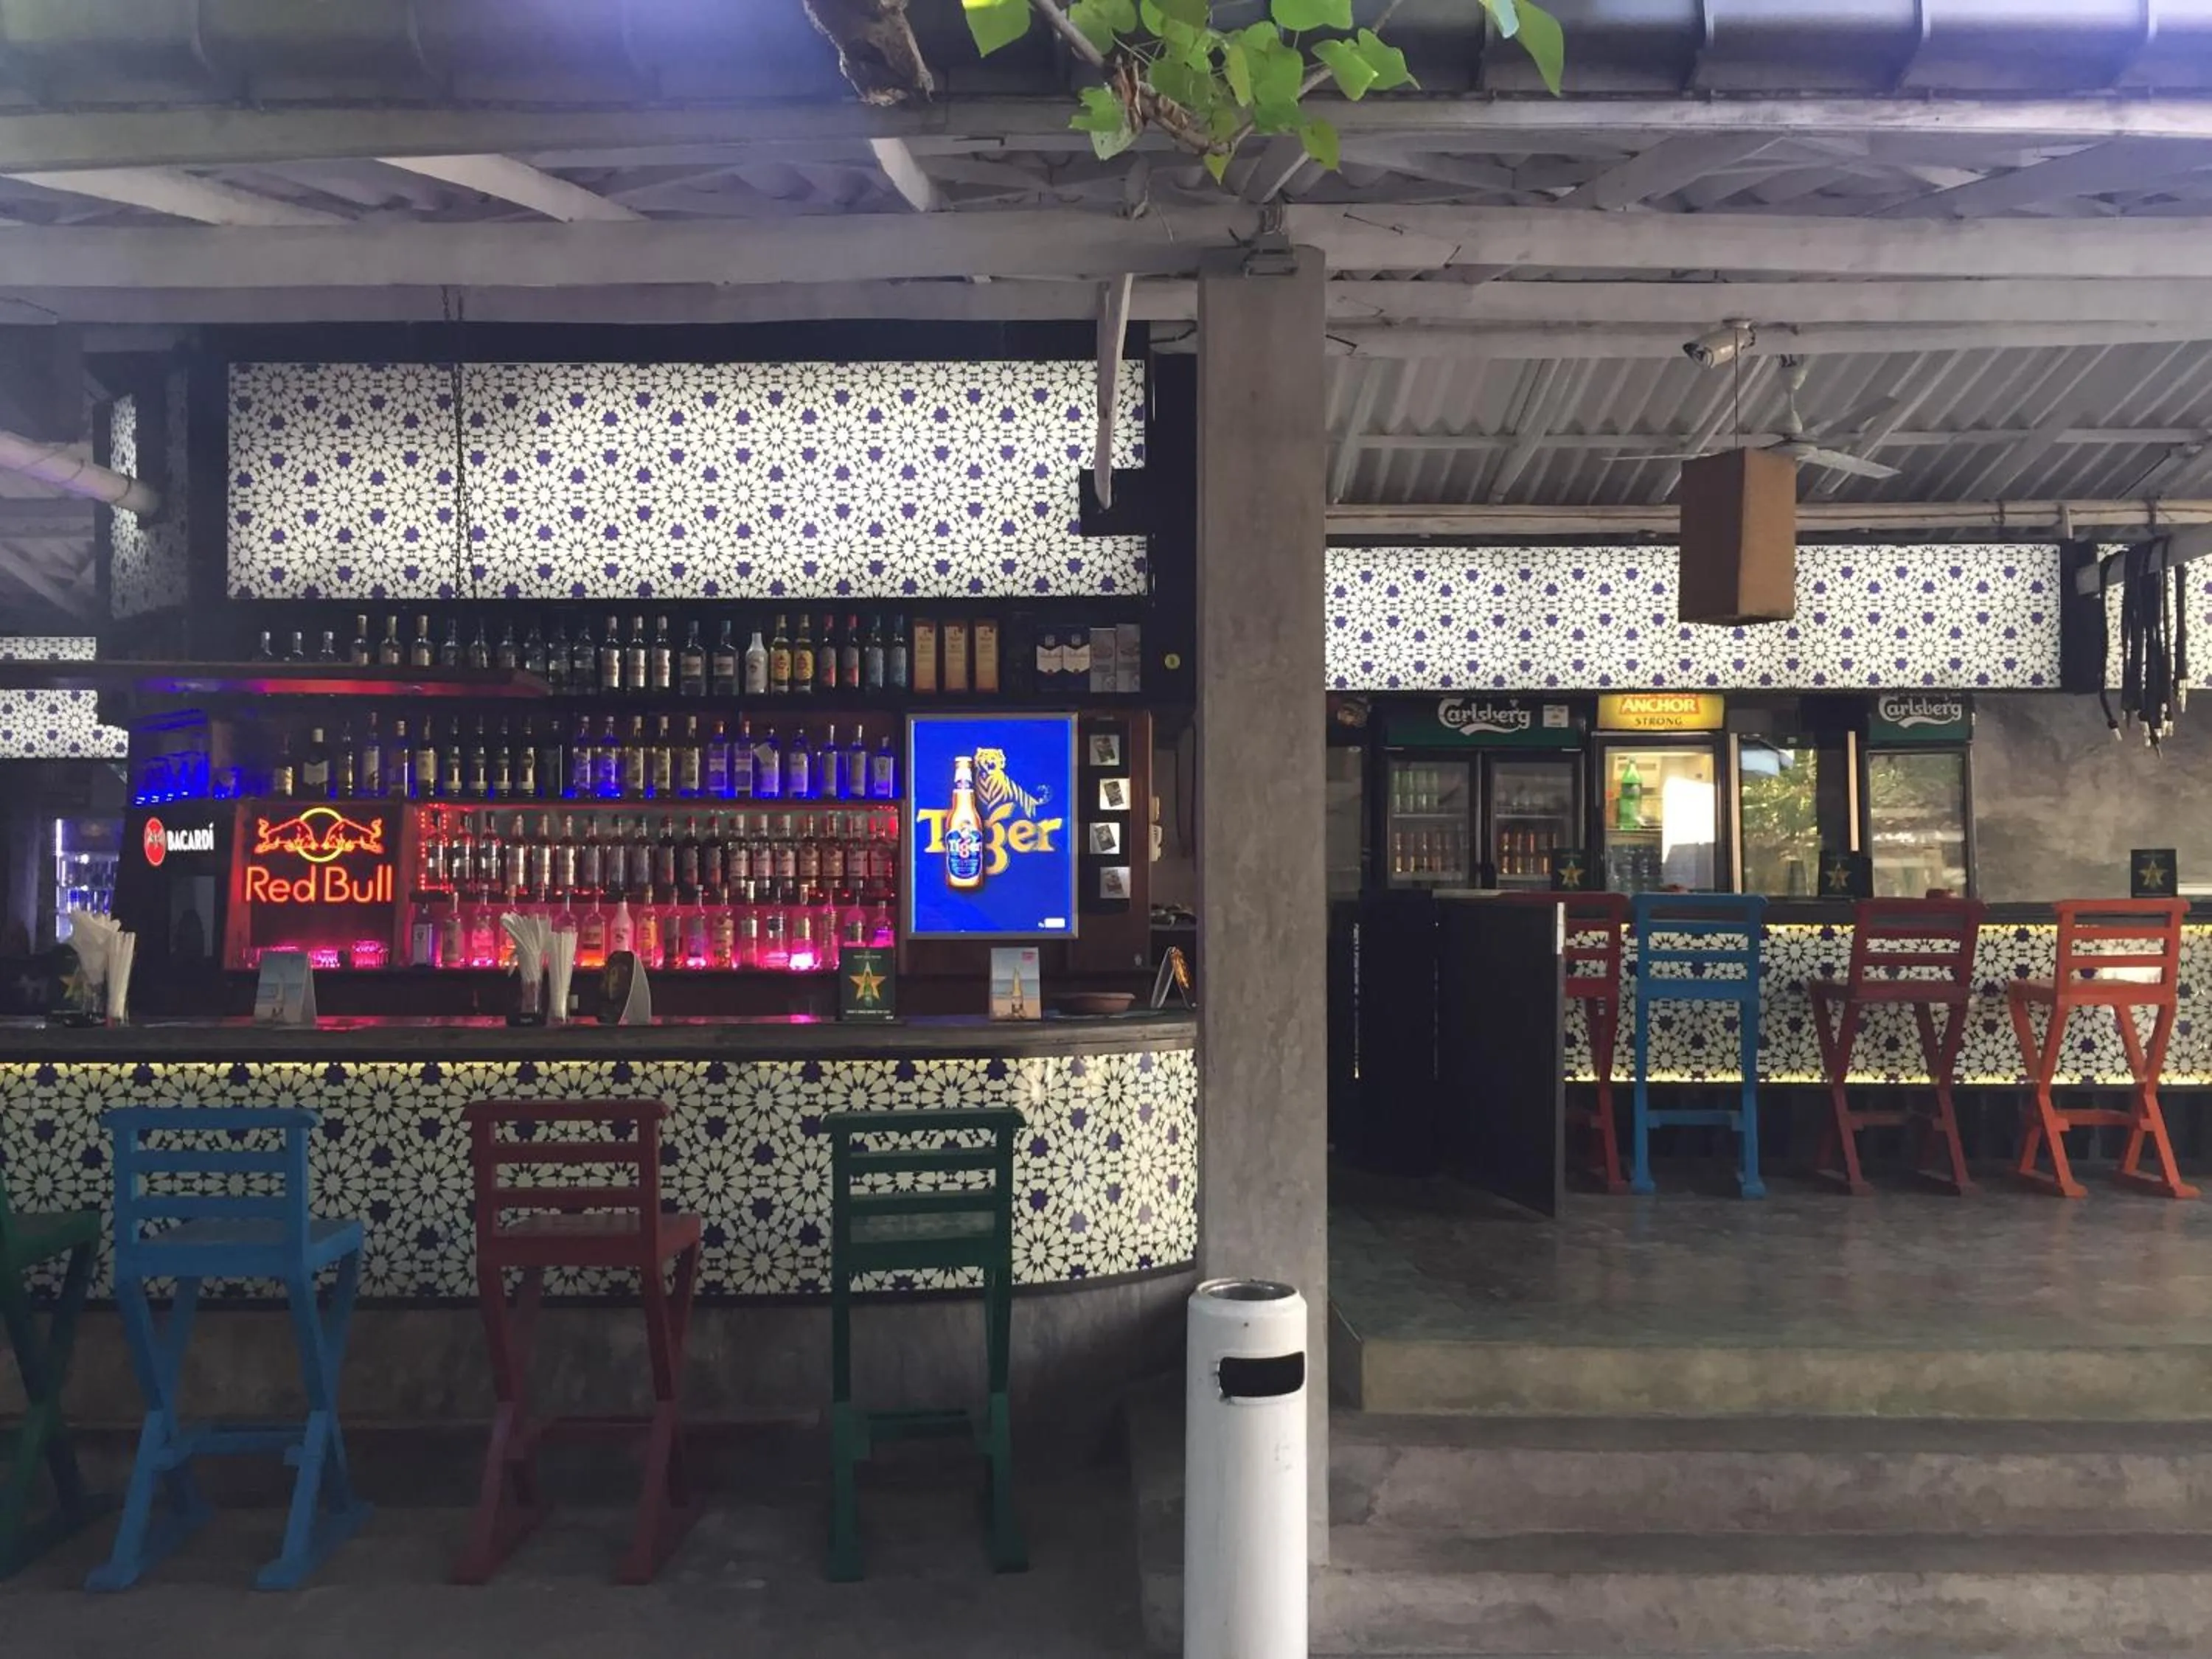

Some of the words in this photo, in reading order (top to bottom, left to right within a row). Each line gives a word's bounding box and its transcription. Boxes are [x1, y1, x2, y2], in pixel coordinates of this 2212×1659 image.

[1438, 697, 1531, 729] Carlsberg
[1622, 698, 1696, 713] ANCHOR
[1878, 695, 1962, 723] Carlsberg
[1635, 717, 1683, 726] STRONG
[166, 821, 214, 851] BACARDÍ
[917, 802, 1062, 876] Tger
[246, 865, 316, 903] Red
[324, 864, 393, 903] Bull
